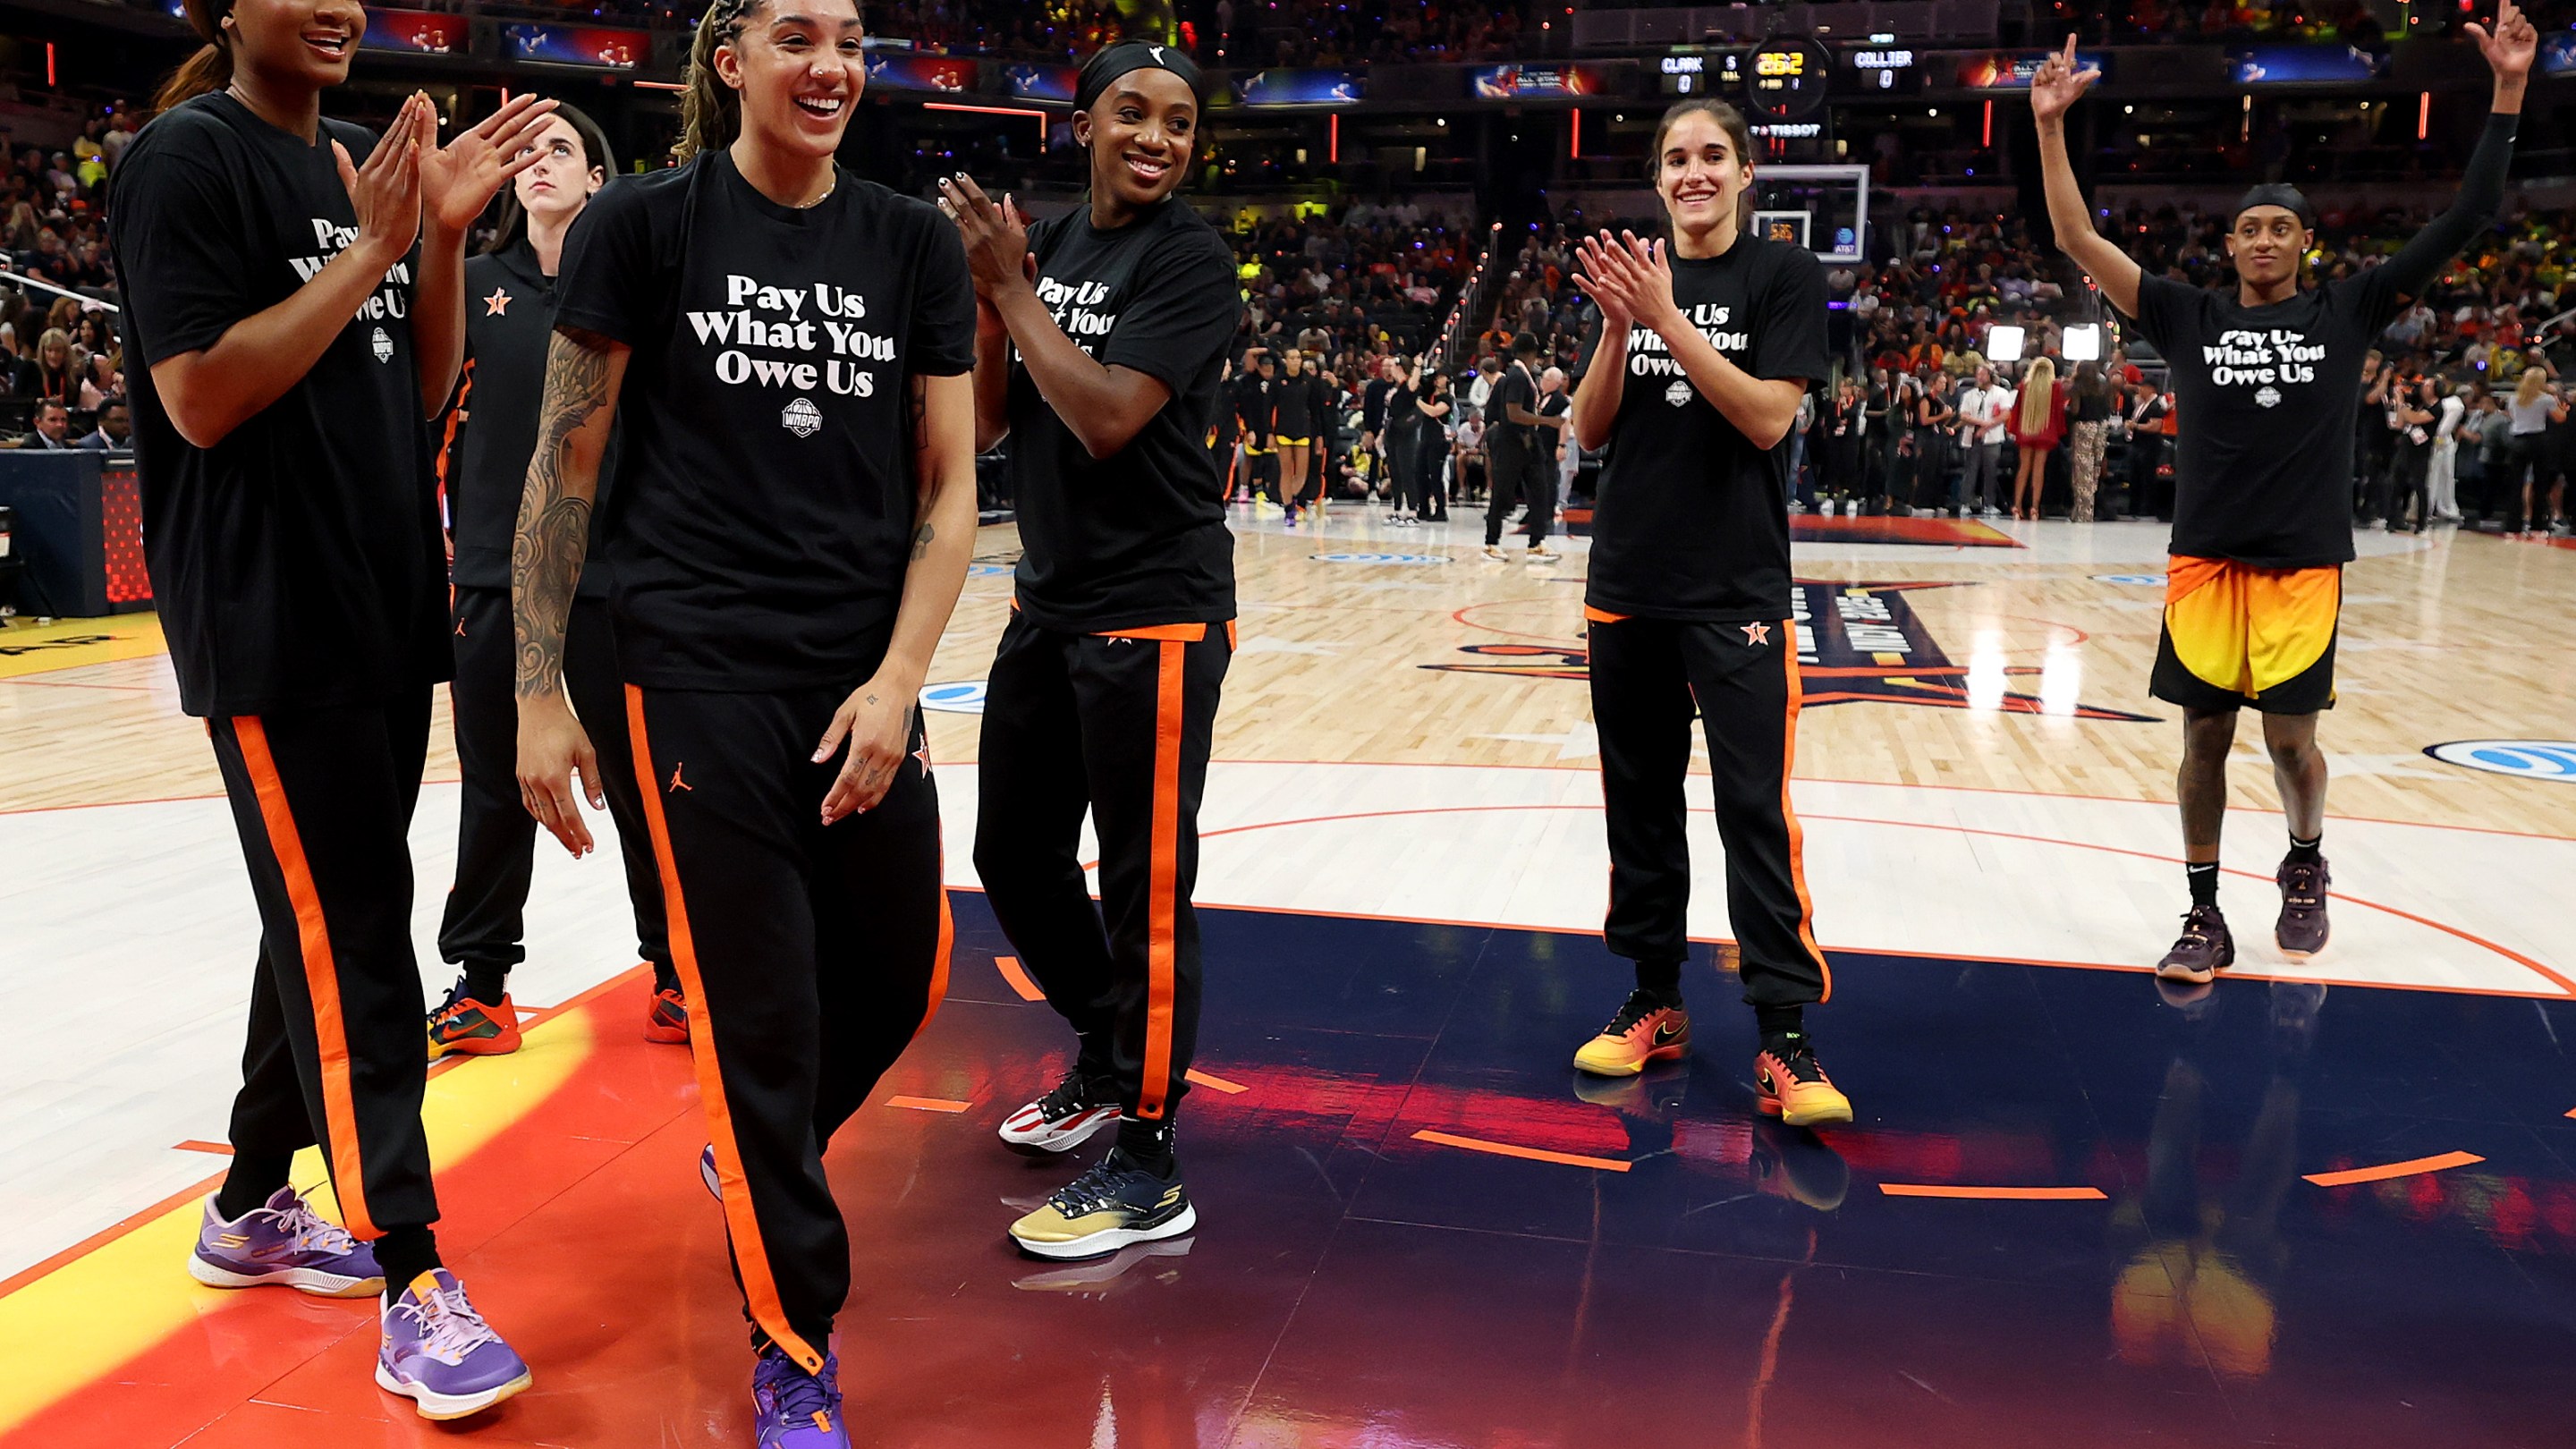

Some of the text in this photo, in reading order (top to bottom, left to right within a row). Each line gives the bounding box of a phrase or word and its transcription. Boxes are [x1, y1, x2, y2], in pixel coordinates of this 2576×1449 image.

[1661, 56, 1703, 73] CLARK
[1854, 51, 1912, 68] COLLIER
[1768, 124, 1820, 137] TISSOT
[727, 275, 866, 321] Pay Us
[1036, 276, 1109, 310] Pay Us
[1068, 308, 1116, 335] You
[1694, 304, 1730, 325] Us
[686, 309, 896, 362] What You
[2219, 329, 2268, 352] Pay
[2202, 343, 2326, 366] What You
[716, 350, 874, 397] Owe Us
[2212, 364, 2315, 386] Owe Us
[785, 412, 820, 428] WNBPA
